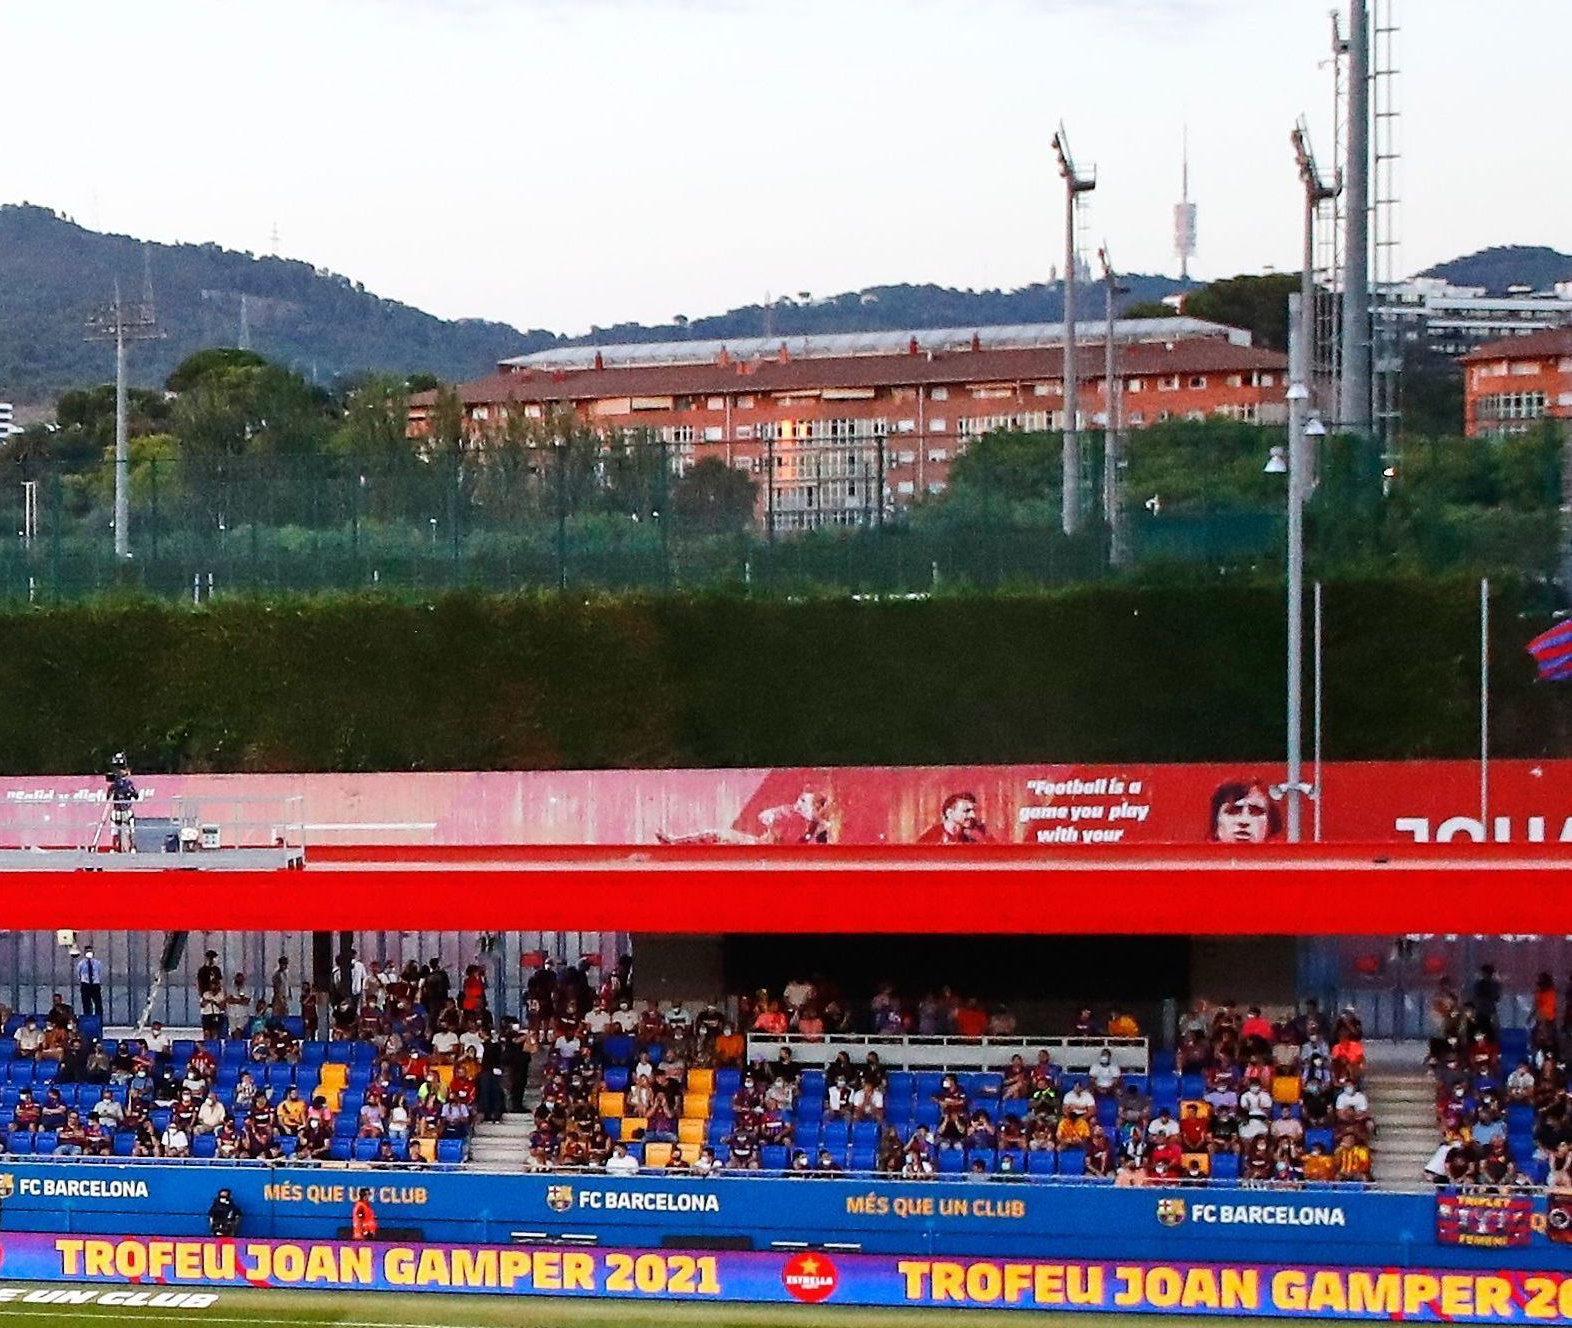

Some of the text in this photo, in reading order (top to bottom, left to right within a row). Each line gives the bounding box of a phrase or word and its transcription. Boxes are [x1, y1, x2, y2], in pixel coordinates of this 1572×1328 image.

[1108, 777, 1125, 795] is
[1128, 781, 1142, 794] a
[1019, 802, 1149, 822] game you play
[1037, 825, 1124, 843] with your
[20, 1179, 149, 1198] FC BARCELONA
[264, 1180, 302, 1202] MÉS
[306, 1184, 344, 1206] QUE
[379, 1186, 428, 1204] CLUB
[579, 1191, 720, 1212] FC BARCELONA
[846, 1191, 1025, 1219] MÉS QUE UN CLUB
[1192, 1204, 1346, 1227] FC BARCELONA
[55, 1239, 720, 1295] TROFEU JOAN GAMPER 2021
[898, 1260, 1102, 1305] TROFEU
[1115, 1265, 1257, 1310] JOAN
[1272, 1269, 1512, 1317] GAMPER
[22, 1290, 98, 1305] UN
[97, 1291, 219, 1309] CLUB
